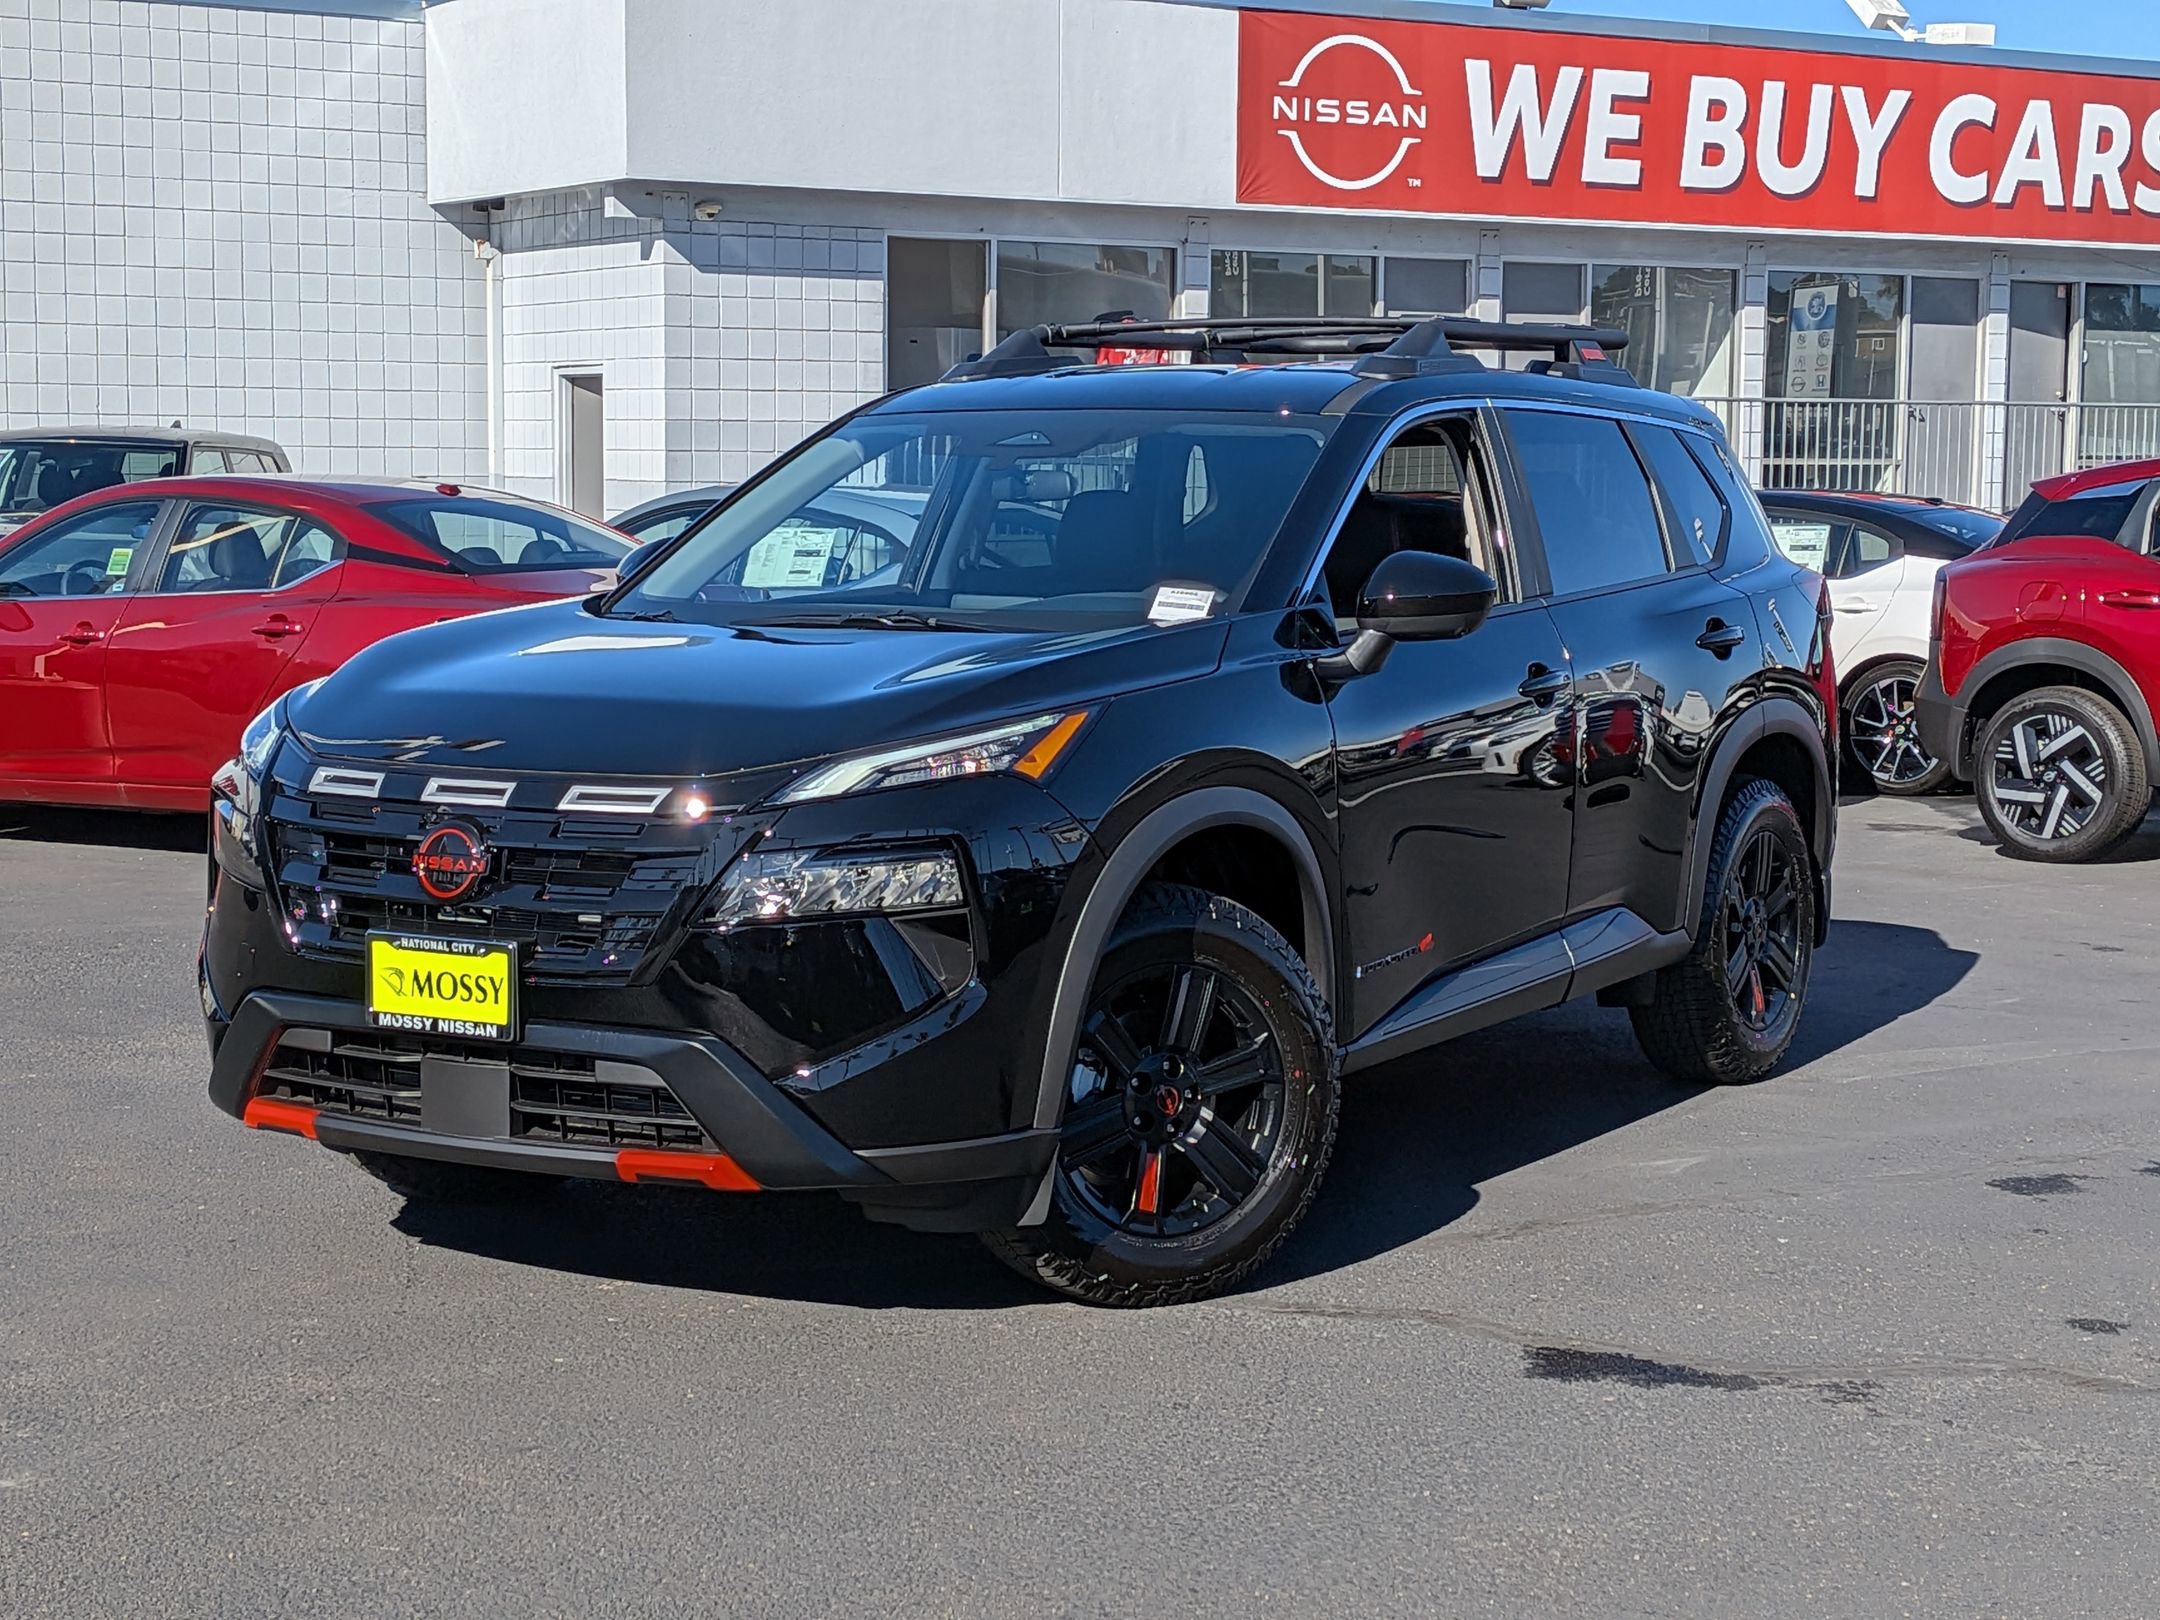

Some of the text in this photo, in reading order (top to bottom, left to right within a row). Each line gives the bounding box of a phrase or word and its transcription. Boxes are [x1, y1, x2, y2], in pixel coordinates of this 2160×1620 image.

[1273, 95, 1427, 129] NISSAN
[1464, 58, 1651, 187] WE
[1679, 75, 1913, 198] BUY
[1407, 178, 1422, 188] TM
[412, 855, 486, 873] NISSAN
[400, 937, 475, 954] NATIONAL CITY
[411, 968, 504, 1005] MOSSY
[378, 1012, 498, 1039] MOSSY NISSAN
